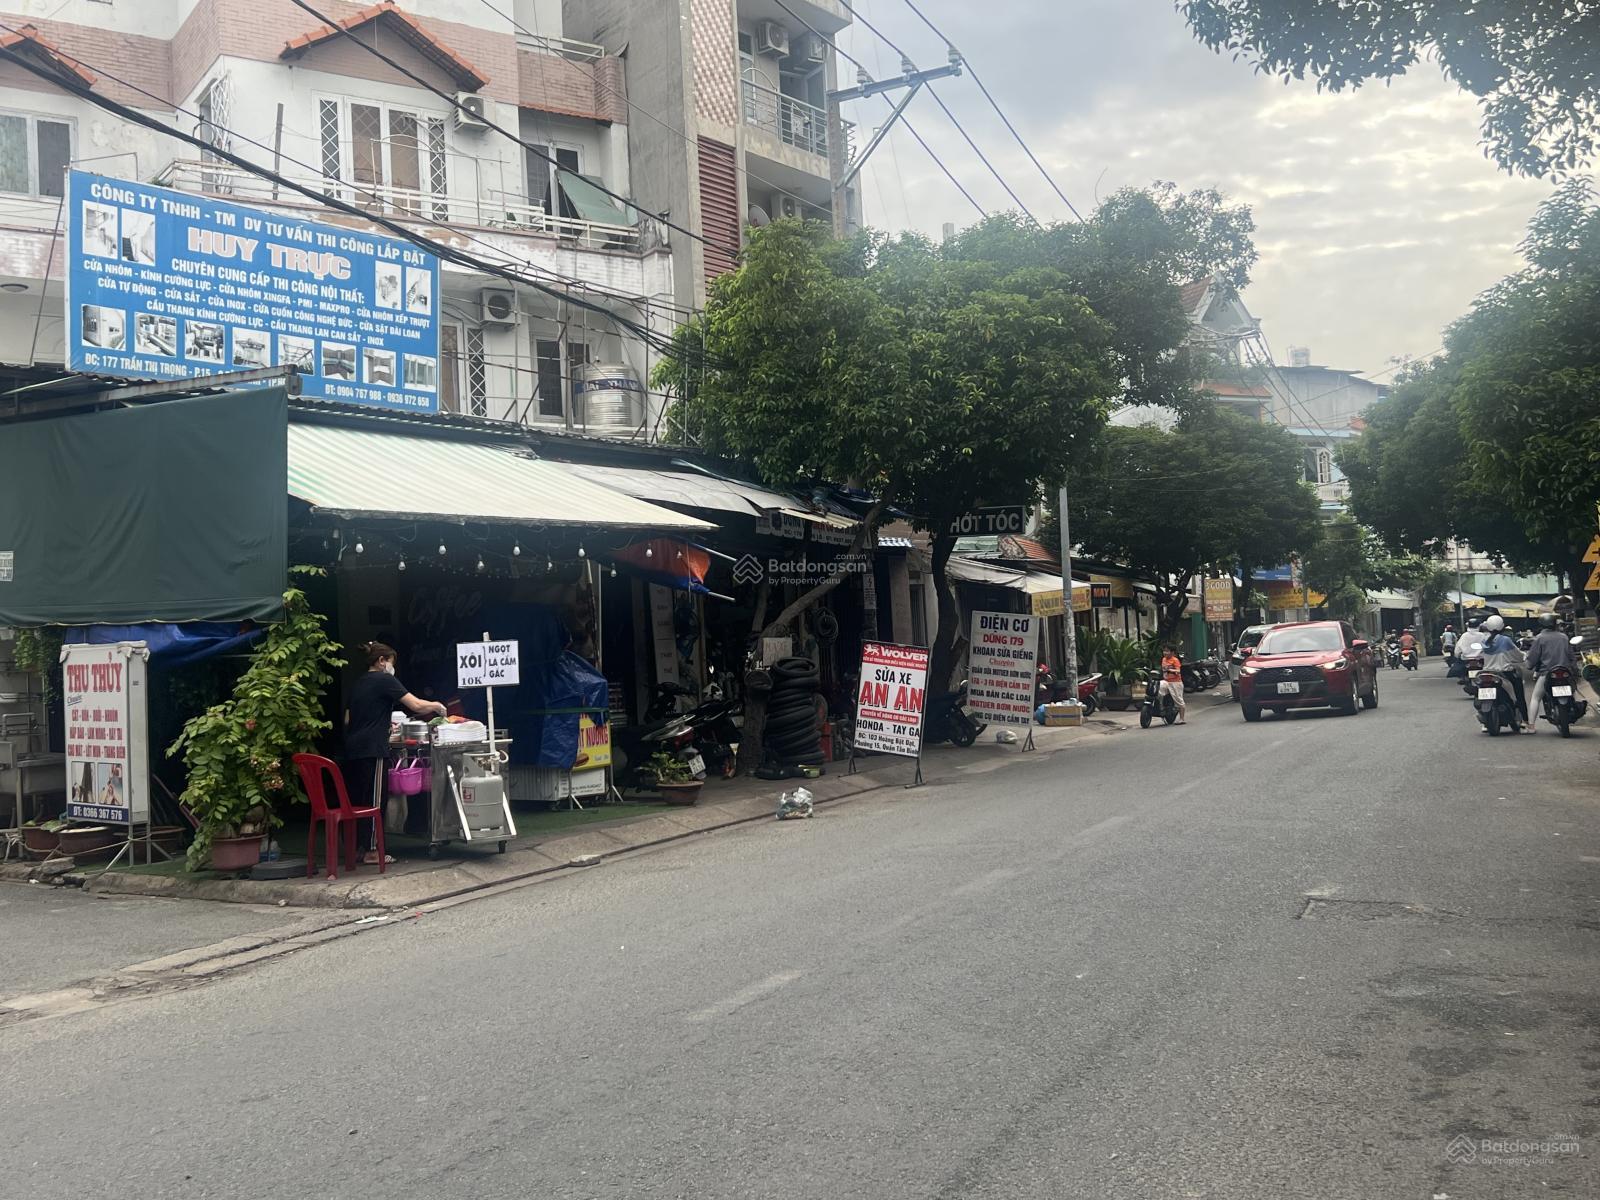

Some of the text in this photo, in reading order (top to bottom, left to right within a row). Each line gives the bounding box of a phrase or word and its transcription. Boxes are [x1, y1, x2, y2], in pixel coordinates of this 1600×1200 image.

[91, 183, 426, 266] CÔNG TY TNHH TM DV TƯ VẤN THI CÔNG LẮP ĐẶT
[188, 227, 352, 280] HUY TRỰC
[105, 264, 132, 277] NHÔM
[264, 292, 290, 304] XINGFA
[298, 298, 312, 308] PMI
[320, 302, 350, 315] MAXPRO
[172, 258, 214, 277] CHUYÊN
[218, 267, 246, 282] CUNG
[250, 271, 270, 286] CẤP
[273, 276, 288, 291] THI
[291, 279, 318, 296] CÔNG
[321, 285, 337, 302] NỘI
[167, 304, 194, 317] THANG
[288, 323, 313, 335] THANG
[315, 328, 328, 338] LAN
[331, 331, 345, 340] CAN
[368, 336, 384, 346] INOX
[227, 299, 246, 310] INOX
[403, 329, 420, 339] LOAN
[102, 354, 118, 368] 177
[986, 509, 1020, 531] TÓC
[980, 614, 1030, 633] ĐIỆN CƠ
[489, 645, 510, 655] NGỌT
[880, 646, 928, 661] WOLVER
[972, 646, 1033, 660] KHOAN SỬA GIẾNG
[460, 652, 481, 668] XÔI
[67, 652, 122, 692] THU THỦY
[462, 676, 482, 685] 10K
[875, 667, 912, 685] SỬA XE
[860, 681, 924, 713] AN AN
[971, 689, 984, 697] MUA
[856, 719, 920, 737] HONDA TAY GA
